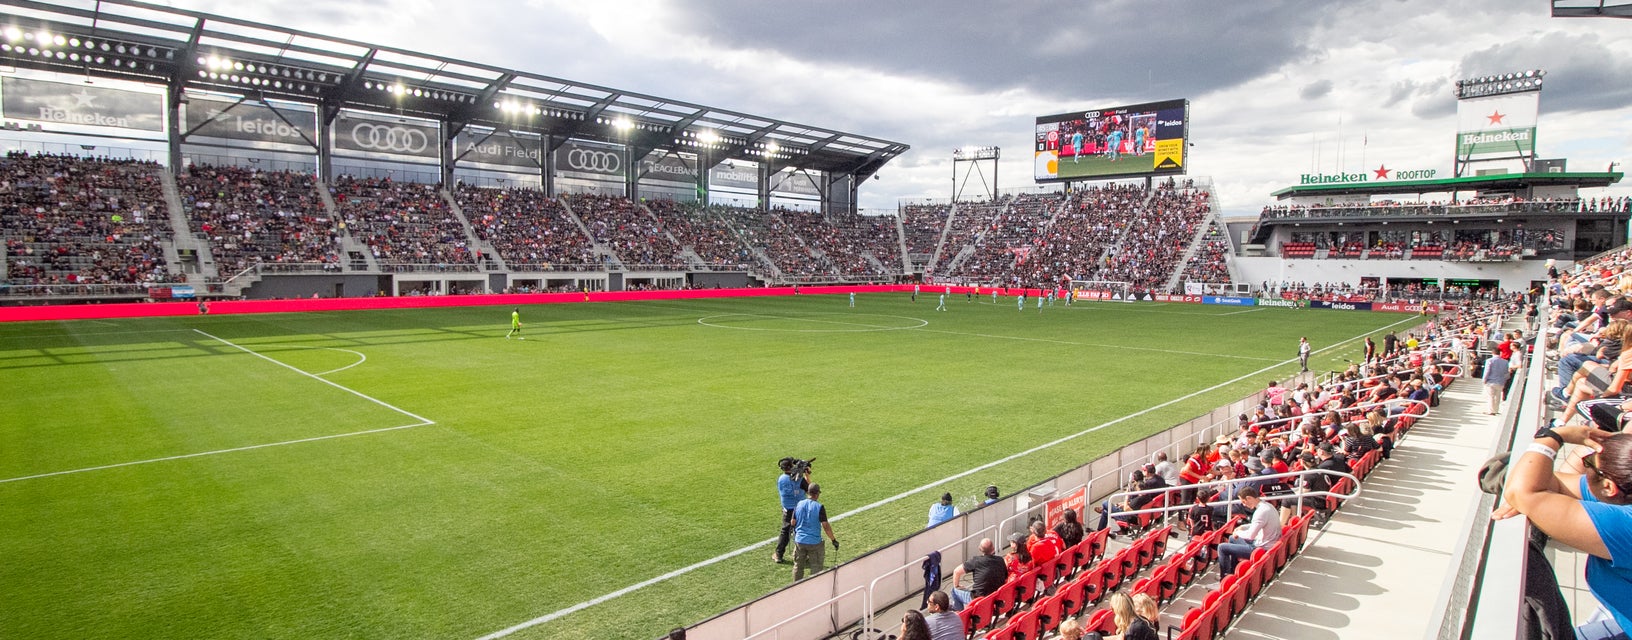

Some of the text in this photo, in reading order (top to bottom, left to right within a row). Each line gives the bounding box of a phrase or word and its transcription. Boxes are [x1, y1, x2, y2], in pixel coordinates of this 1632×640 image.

[39, 106, 129, 127] Heineken
[1164, 119, 1182, 127] leidos
[236, 114, 301, 138] leidos
[1463, 129, 1529, 145] Heineken
[466, 141, 538, 160] Audi Field
[1300, 169, 1437, 185] Heineken ROOFTOP
[1331, 302, 1355, 310] leidos
[1381, 303, 1400, 311] Audi
[1200, 514, 1208, 527] 9
